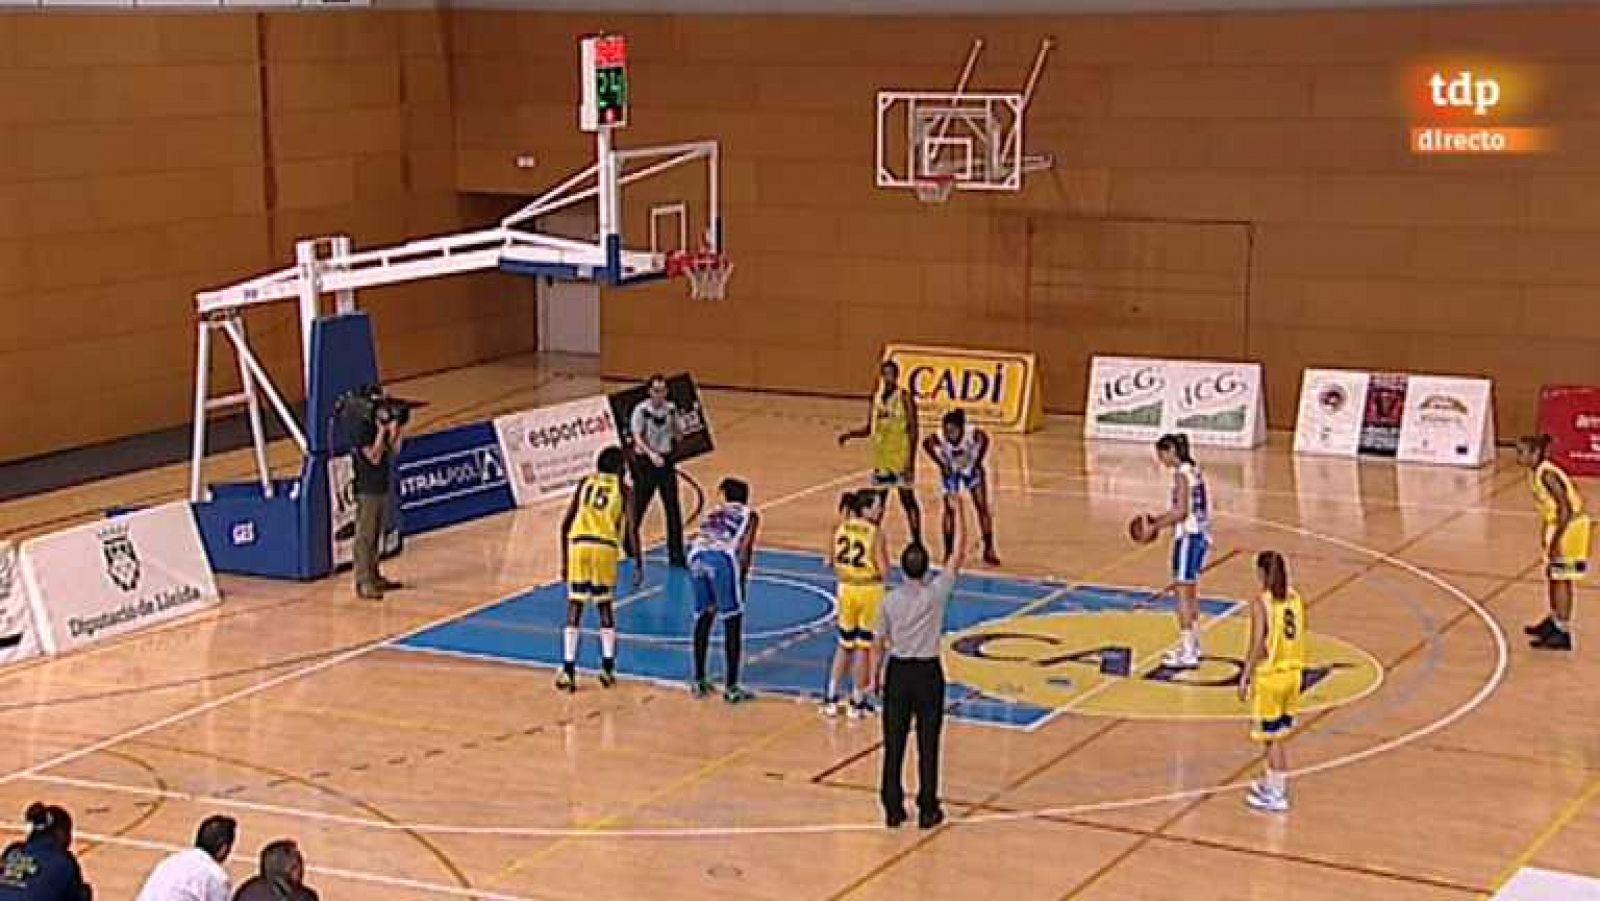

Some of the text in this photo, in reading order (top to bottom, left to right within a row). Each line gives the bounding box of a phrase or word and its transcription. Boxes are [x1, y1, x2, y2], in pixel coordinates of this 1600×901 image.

[528, 409, 611, 449] esportcat
[584, 484, 611, 510] 15
[836, 535, 867, 568] 22
[1282, 608, 1297, 641] 8
